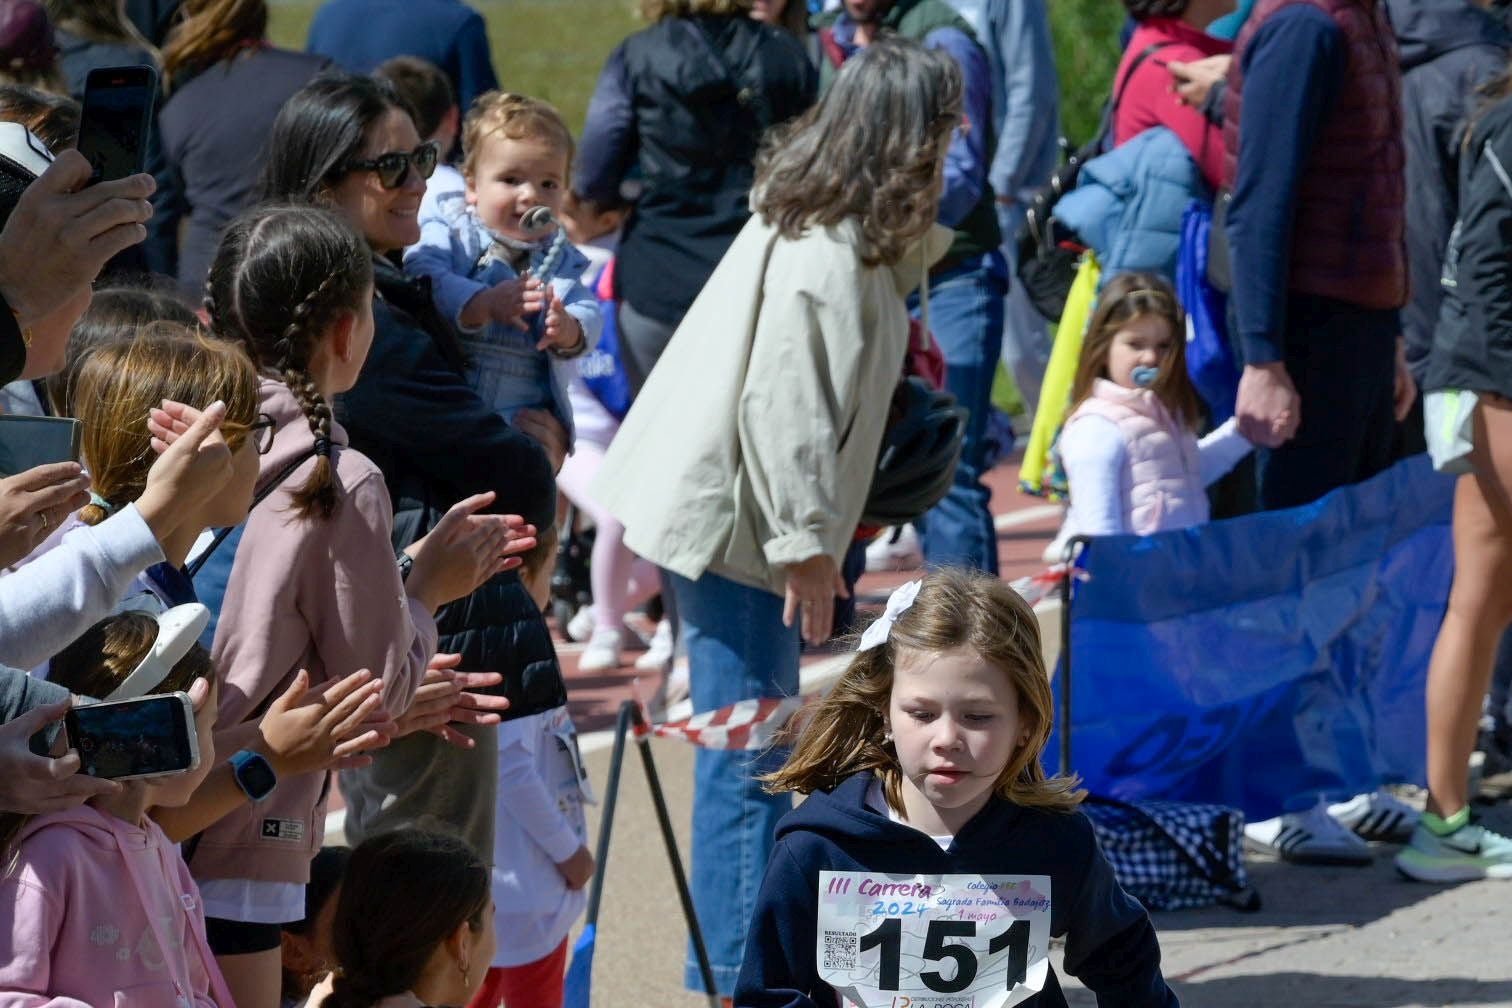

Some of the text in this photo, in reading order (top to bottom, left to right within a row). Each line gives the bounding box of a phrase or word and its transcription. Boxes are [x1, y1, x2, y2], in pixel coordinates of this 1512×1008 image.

[828, 877, 932, 898] III Carrera
[871, 901, 929, 918] 2024
[936, 897, 972, 912] Sagrada
[975, 896, 1010, 906] Familia
[958, 909, 998, 926] 1 mayo
[859, 918, 1031, 994] 151
